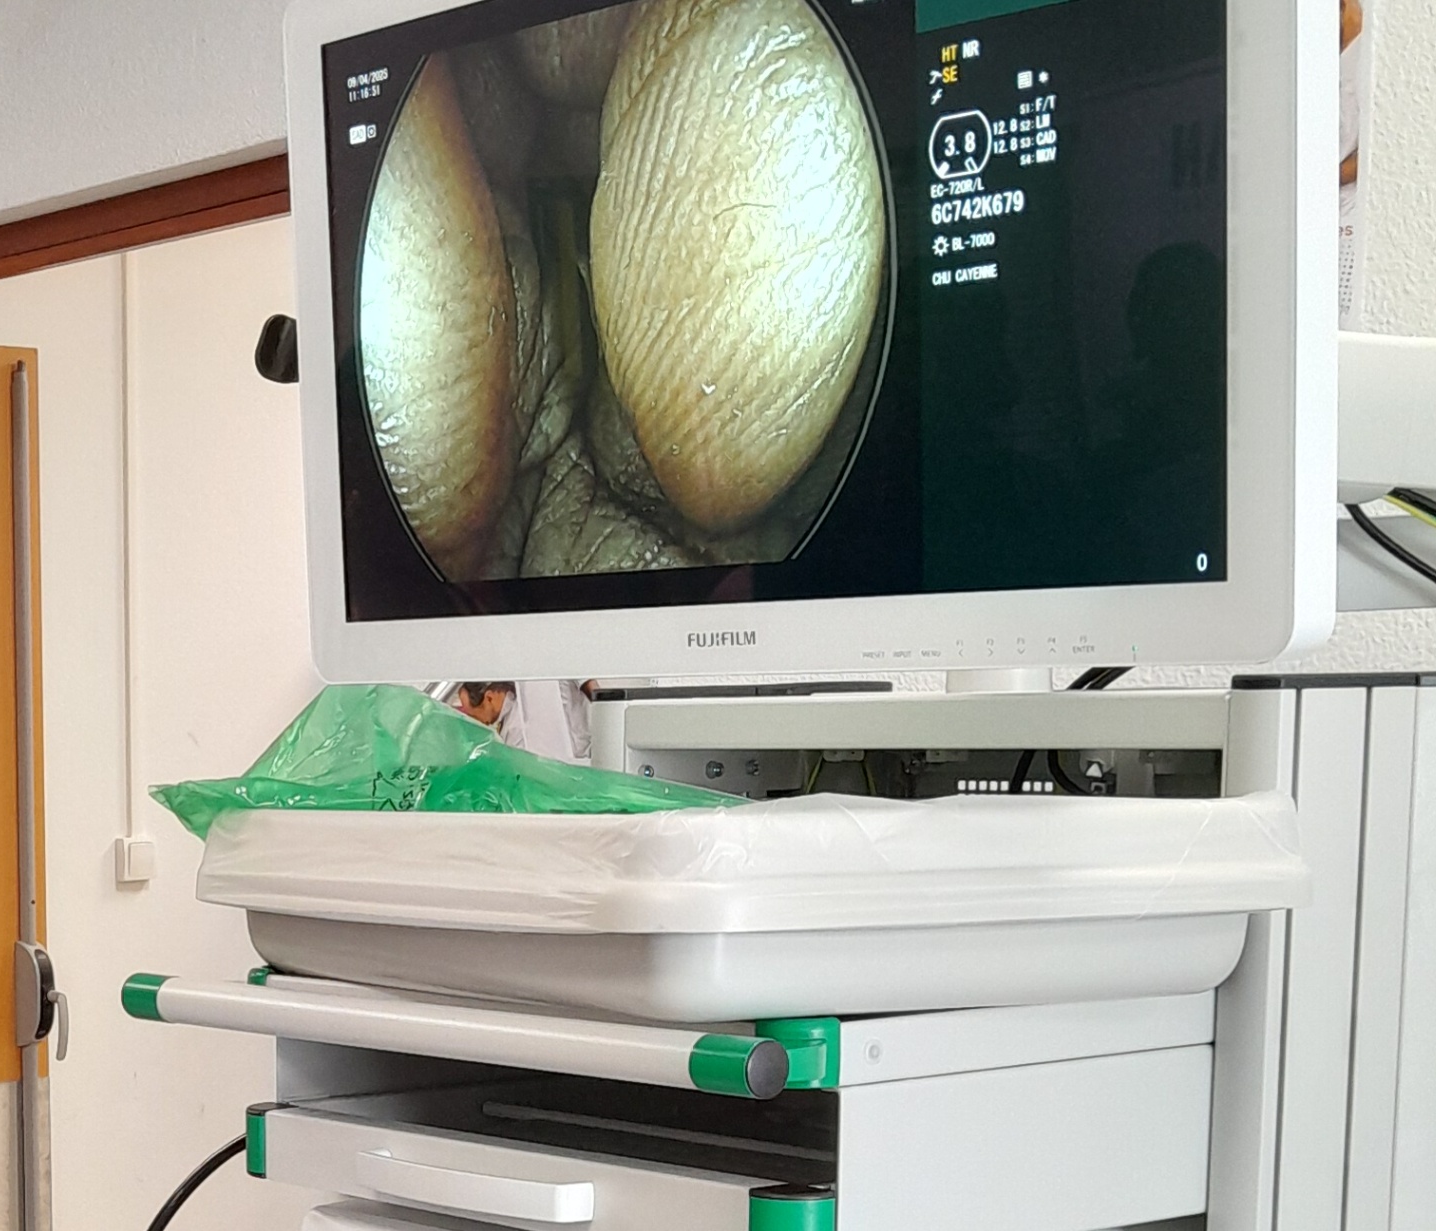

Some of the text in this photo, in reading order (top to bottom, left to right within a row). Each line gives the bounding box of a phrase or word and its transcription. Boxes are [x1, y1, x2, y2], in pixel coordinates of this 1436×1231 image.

[942, 40, 980, 62] HT NR
[942, 65, 958, 83] SE
[349, 84, 380, 102] 11:16:51
[932, 190, 1025, 225] 6C742K679
[951, 232, 995, 251] BL-7000
[932, 263, 998, 286] CHU CAYENNE
[1196, 553, 1208, 571] 0
[687, 631, 756, 648] FUJIFILM
